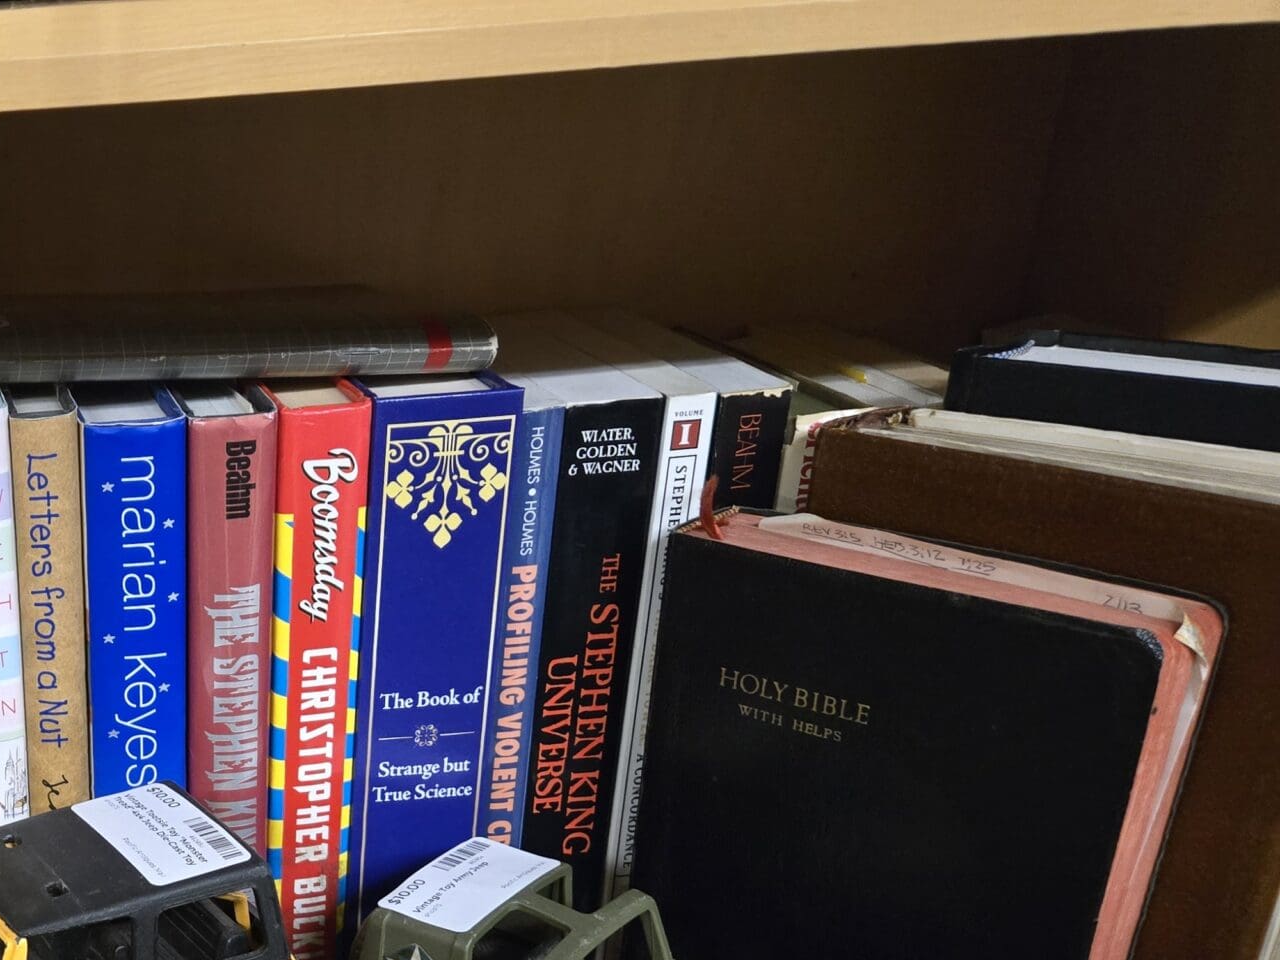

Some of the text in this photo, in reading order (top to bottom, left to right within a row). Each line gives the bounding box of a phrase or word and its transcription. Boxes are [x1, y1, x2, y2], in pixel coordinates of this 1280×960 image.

[674, 409, 705, 418] VOLUME
[225, 440, 256, 520] Beahm
[568, 459, 641, 476] & WAGNER
[576, 443, 637, 460] GOLDEN
[730, 413, 762, 490] BEAHM
[26, 453, 60, 577] Letters
[520, 426, 545, 556] HOLMES HOLMES
[120, 455, 166, 632] marian
[300, 447, 359, 623] Boomsday
[31, 587, 65, 661] from
[499, 564, 538, 706] PROFILING
[37, 671, 58, 690] a
[204, 583, 261, 850] THE STEPHEN KIN
[380, 685, 483, 710] The Book of
[562, 553, 621, 856] THE STEPHEN KING
[720, 666, 871, 726] HOLY BIBLE
[38, 699, 69, 748] Nut
[114, 653, 167, 787] keyes
[293, 646, 337, 864] CHRISTOPHER
[532, 654, 579, 814] UNIVERSE
[738, 703, 843, 743] WITH HELPS
[146, 786, 181, 809] $10.00
[372, 783, 472, 802] True Science
[378, 757, 471, 780] Strange but
[489, 712, 523, 813] VIOLENT
[387, 878, 426, 906] $10.00
[412, 891, 442, 914] Vintage
